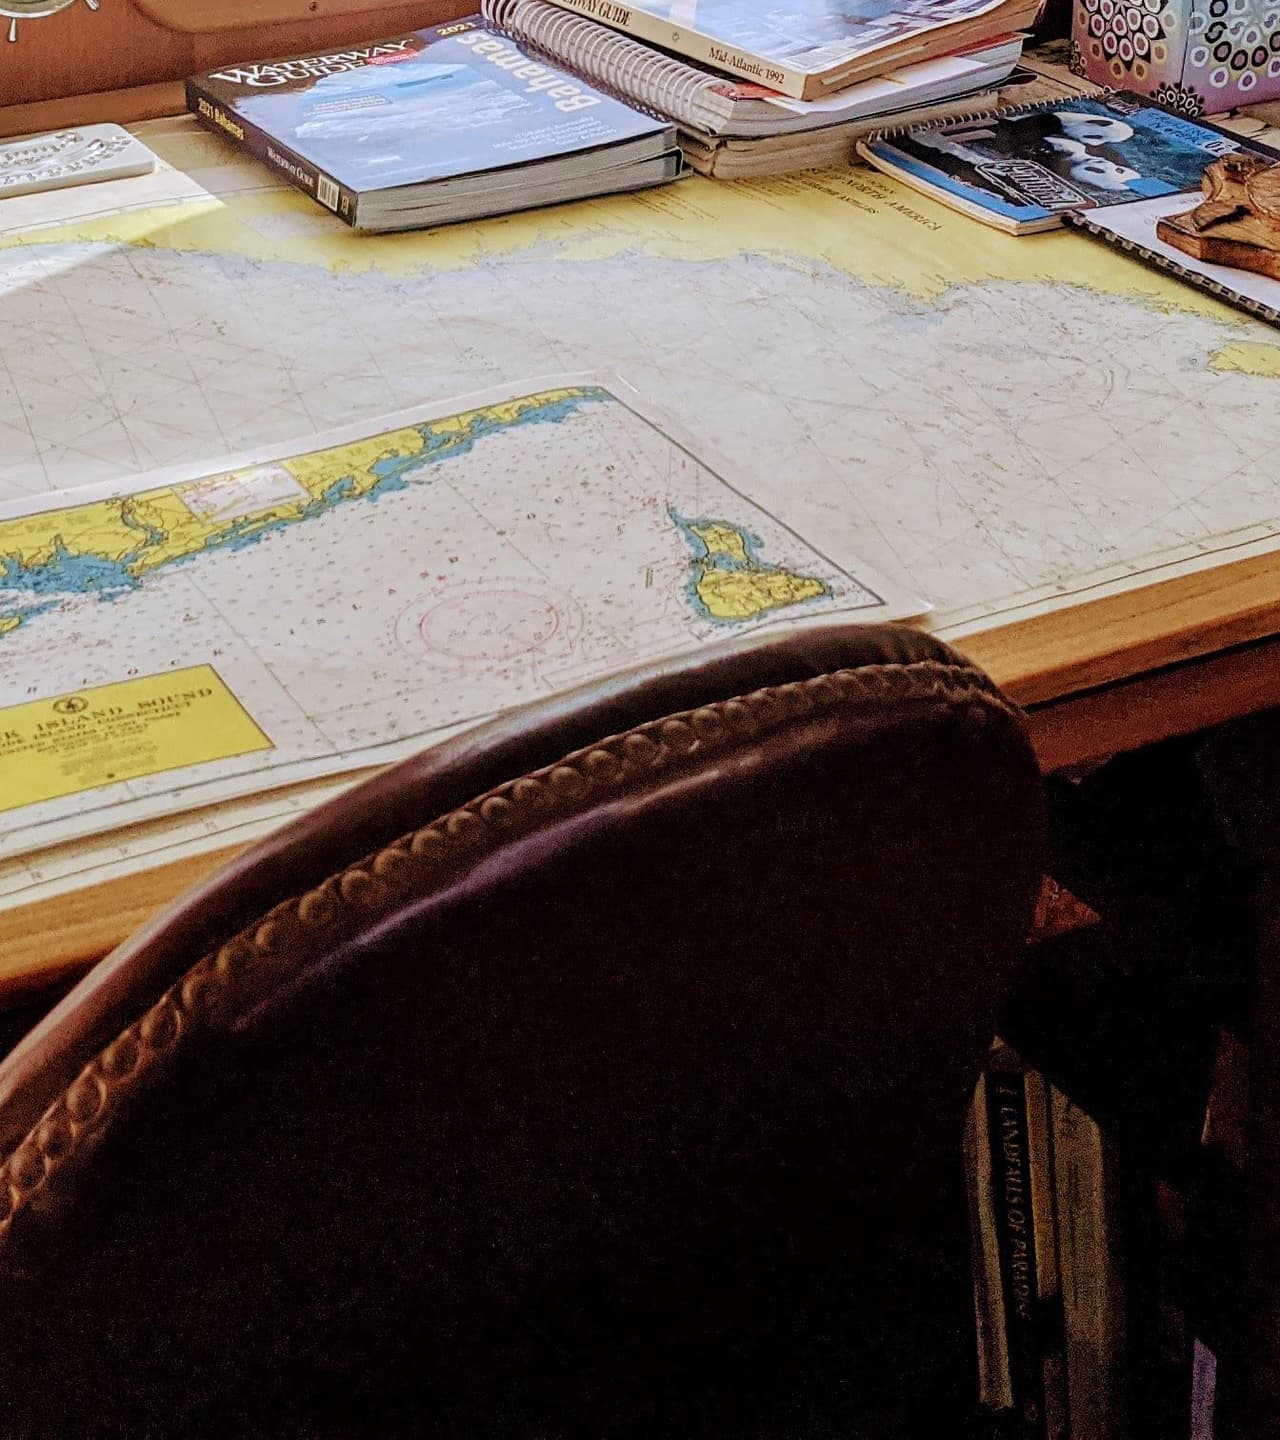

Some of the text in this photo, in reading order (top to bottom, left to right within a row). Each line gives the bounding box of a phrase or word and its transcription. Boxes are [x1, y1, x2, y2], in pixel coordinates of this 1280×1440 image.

[598, 0, 633, 28] GUIDE
[437, 21, 478, 38] 2021
[207, 38, 415, 85] WATERWAY
[246, 59, 369, 88] GUIDE
[456, 31, 603, 114] Bahamas
[707, 45, 786, 86] Mid-Atlantic 1992
[197, 97, 217, 122] 2021
[36, 705, 124, 732] ISLAND
